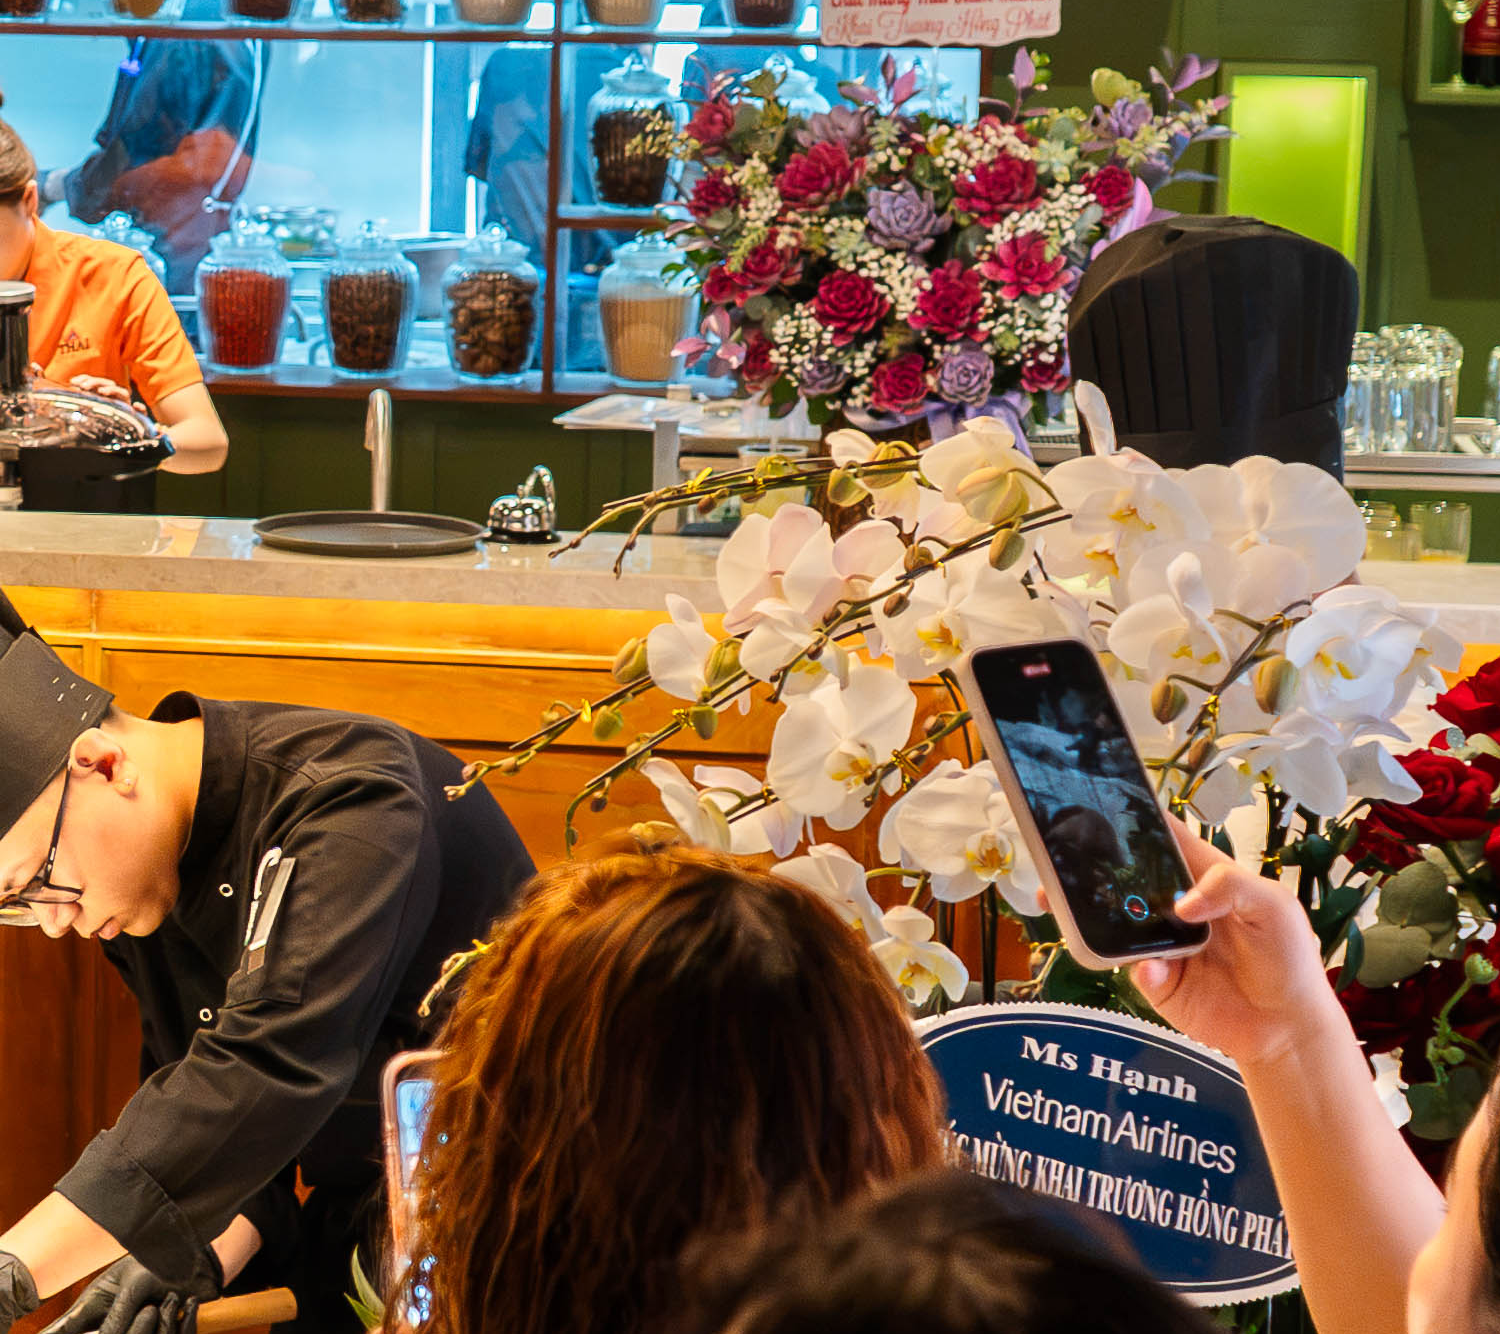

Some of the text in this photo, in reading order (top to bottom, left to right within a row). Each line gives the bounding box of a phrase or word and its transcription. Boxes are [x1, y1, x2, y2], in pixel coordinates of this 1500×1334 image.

[1019, 1035, 1198, 1103] Ms Hạnh
[972, 1131, 1032, 1189] MỪNG
[1032, 1154, 1085, 1204] KHAI
[1085, 1169, 1174, 1228] TRƯƠNG
[1175, 1177, 1240, 1246] HỒNG
